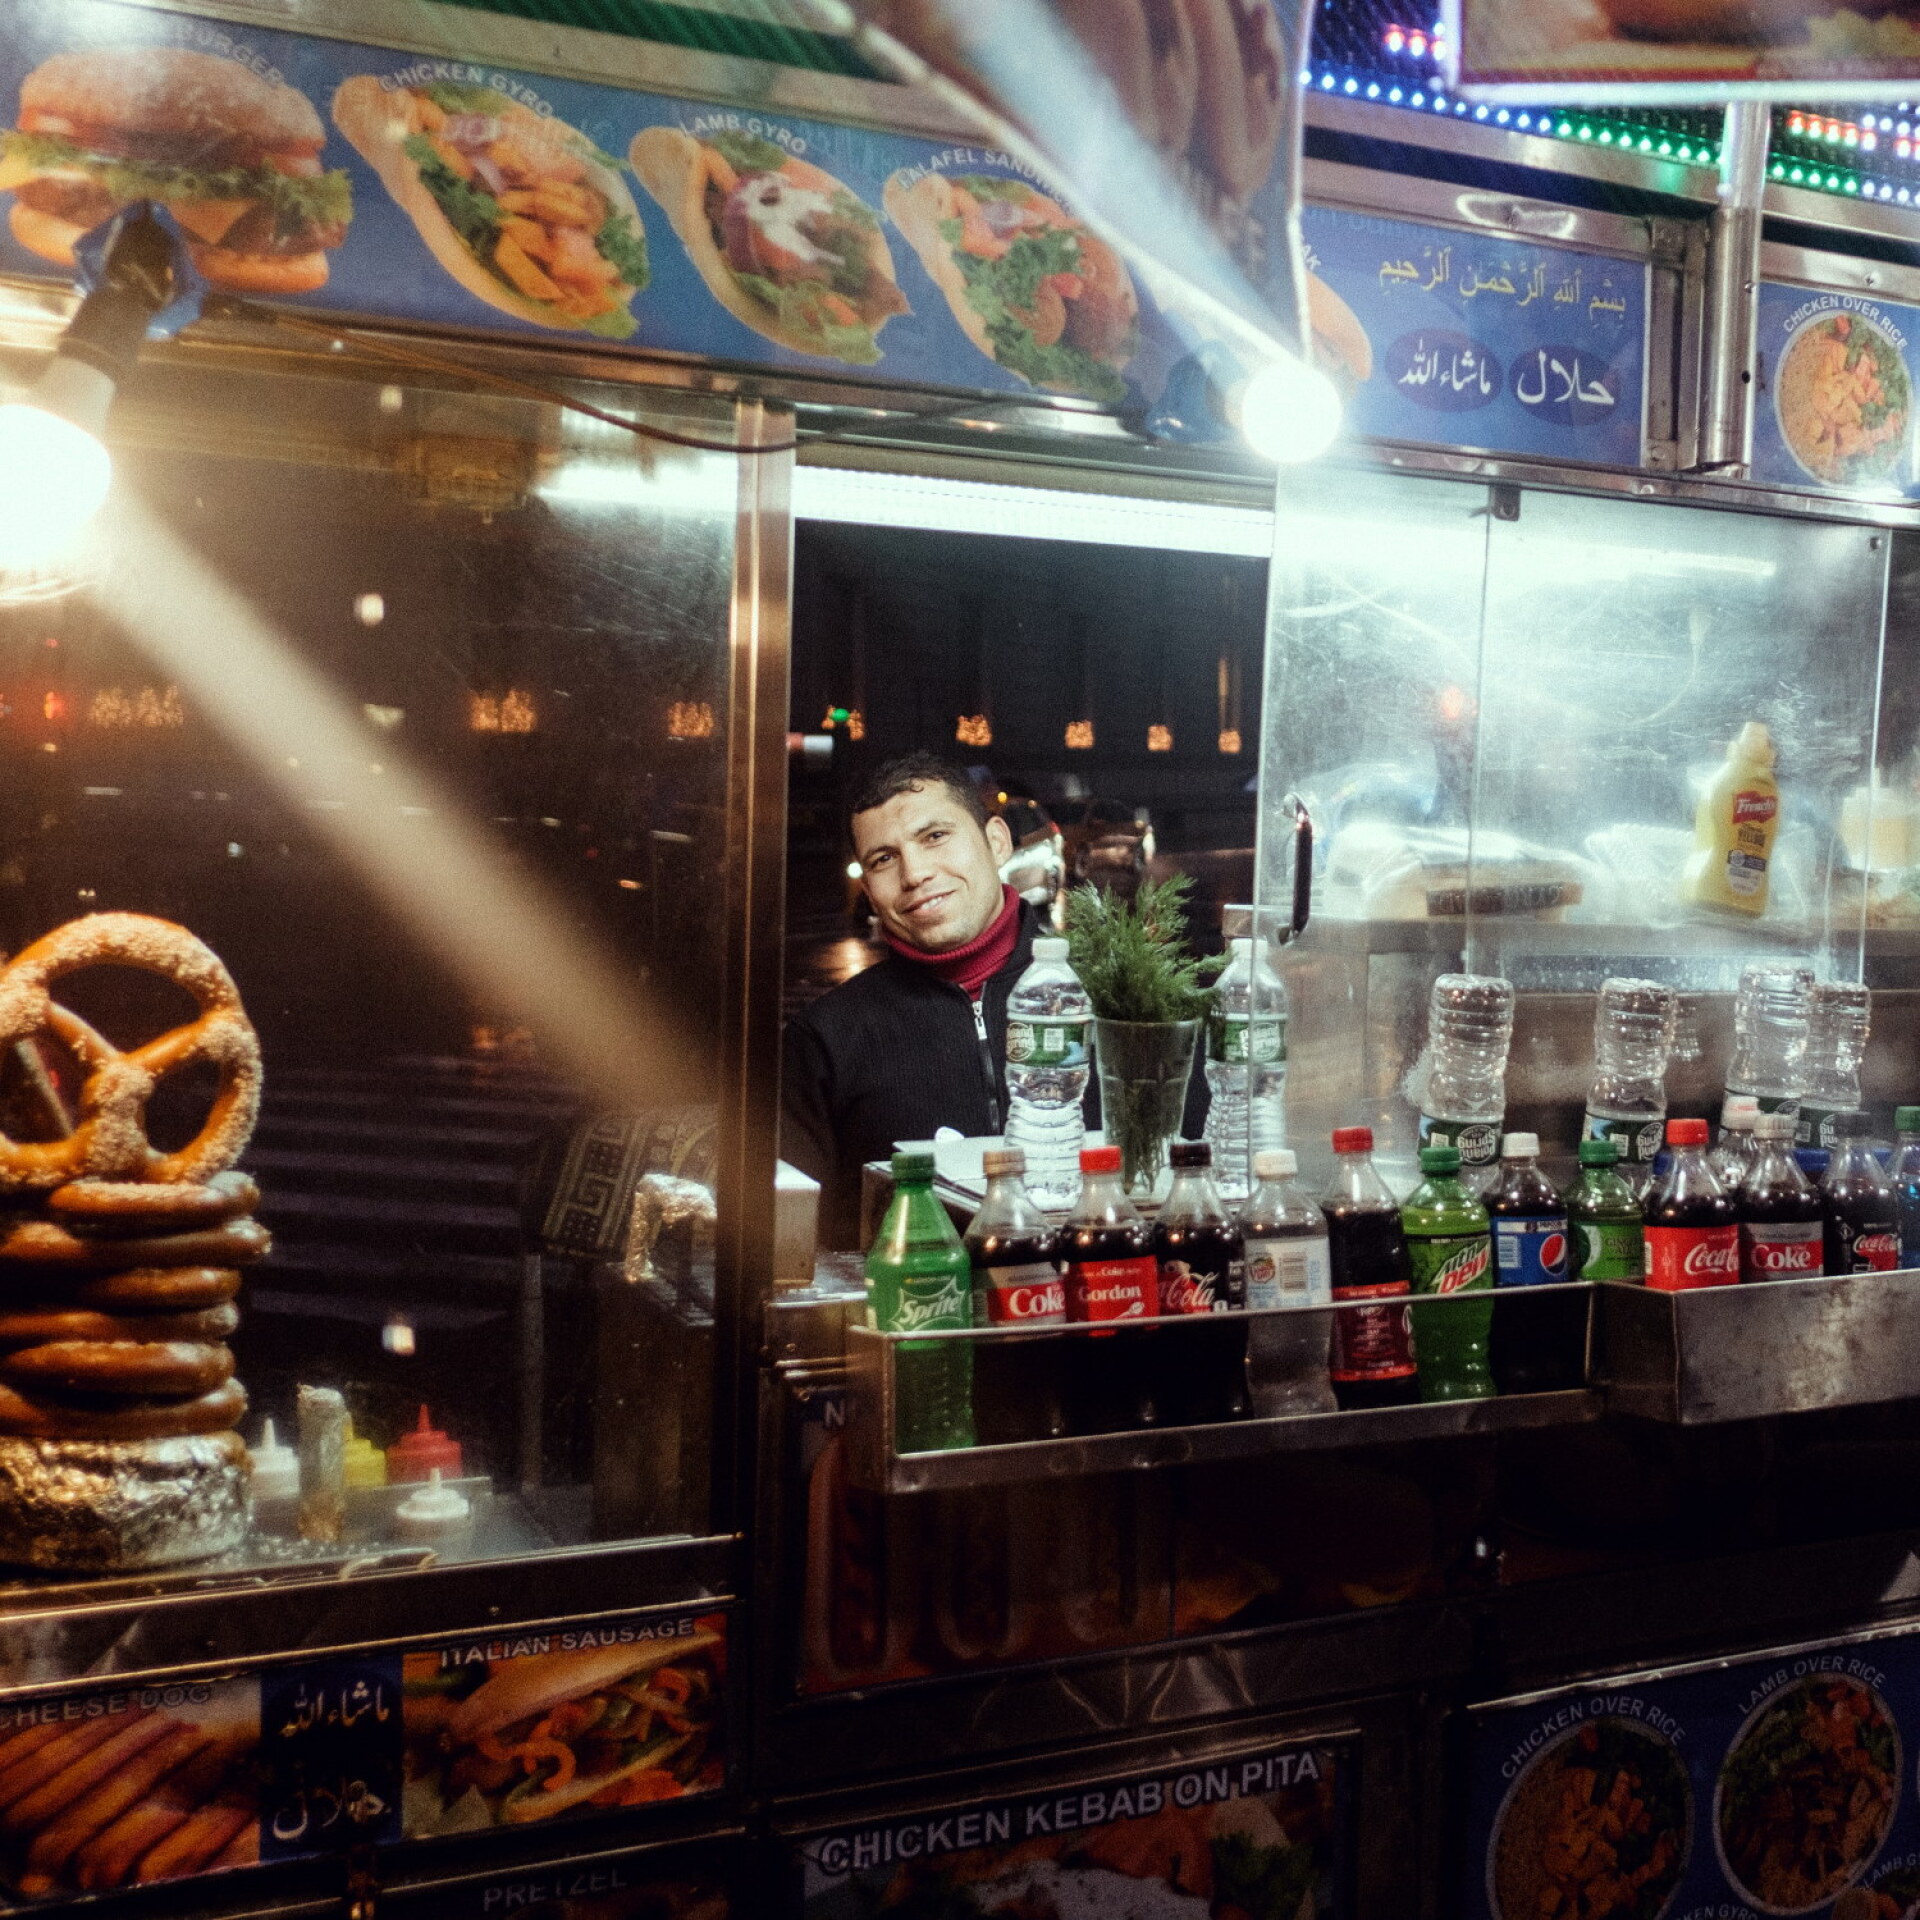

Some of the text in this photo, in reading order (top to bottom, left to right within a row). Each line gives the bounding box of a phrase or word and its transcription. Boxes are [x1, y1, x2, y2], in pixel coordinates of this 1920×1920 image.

[379, 62, 553, 118] CHICKEN GYRO
[680, 113, 807, 154] LAMB GYRO
[1783, 296, 1909, 349] CHICKEN OVER RICE
[1751, 1244, 1811, 1269] Coke
[900, 1295, 960, 1326] Sprite
[1078, 1283, 1143, 1303] Gordon
[442, 1617, 695, 1668] ITALIAN SAUSAGE
[139, 1685, 210, 1709] DOG
[1738, 1655, 1886, 1715] LAMB OVER RICE
[1501, 1695, 1687, 1779] CHICKEN OVER RICE
[821, 1750, 1319, 1875] CHICKEN KEBAB ON PITA
[1863, 1855, 1903, 1889] LAMB
